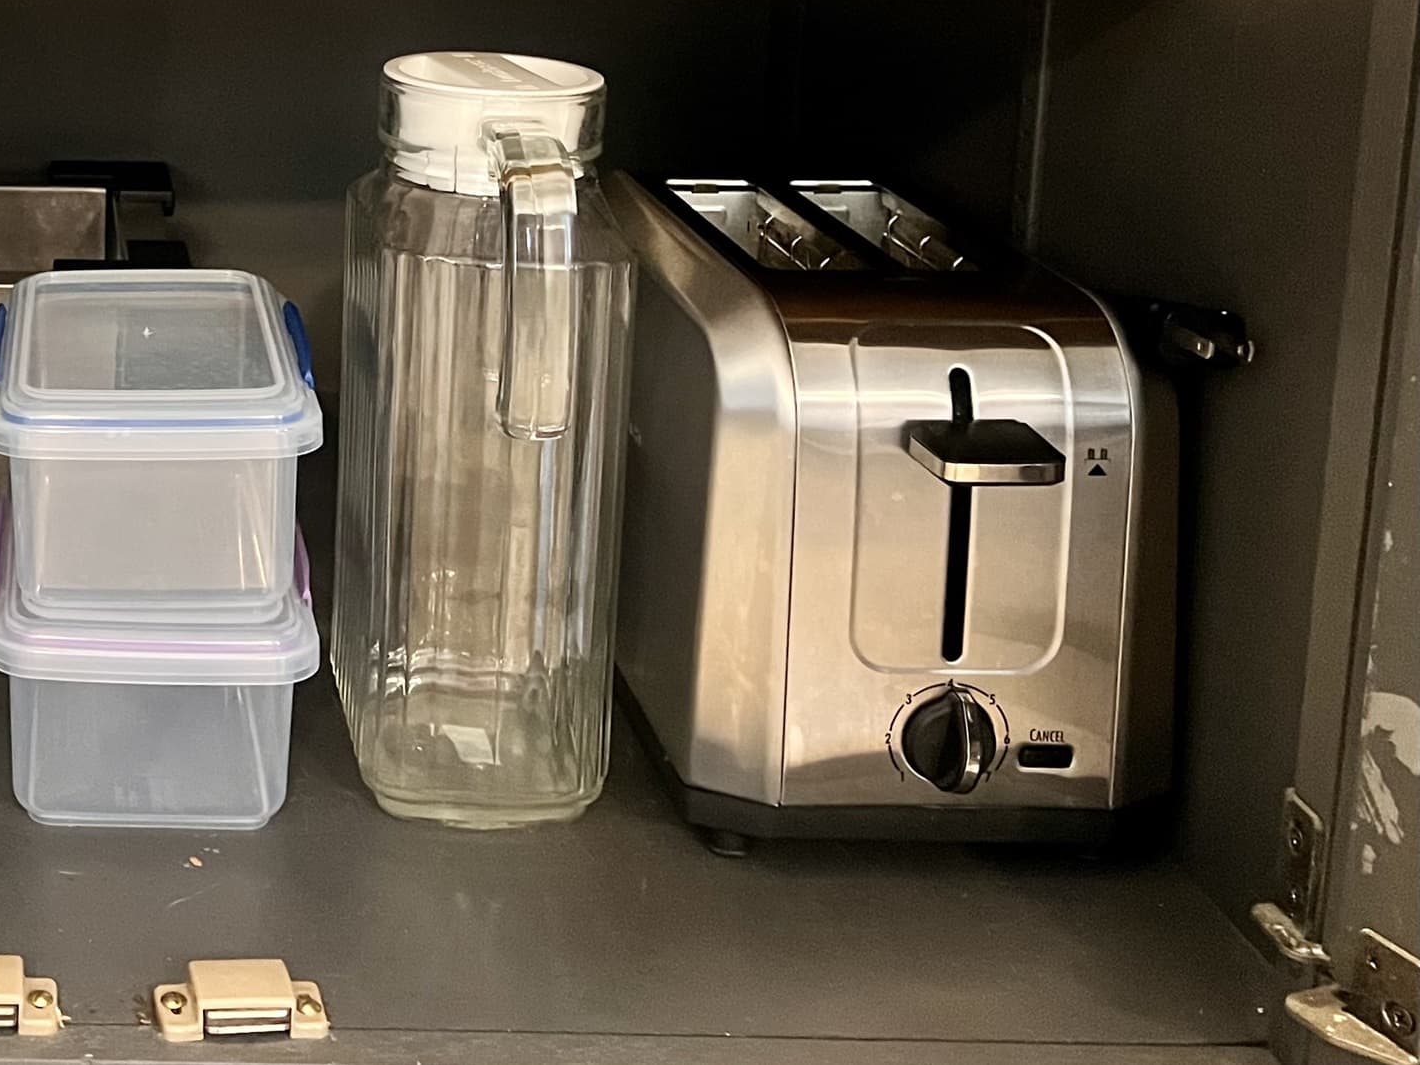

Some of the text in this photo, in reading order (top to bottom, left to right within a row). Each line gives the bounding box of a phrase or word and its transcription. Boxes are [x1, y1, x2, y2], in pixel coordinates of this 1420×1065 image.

[905, 693, 912, 704] 3
[989, 693, 996, 704] 5
[884, 733, 892, 743] 2
[1004, 733, 1011, 743] 6
[1029, 729, 1065, 743] CANCEL
